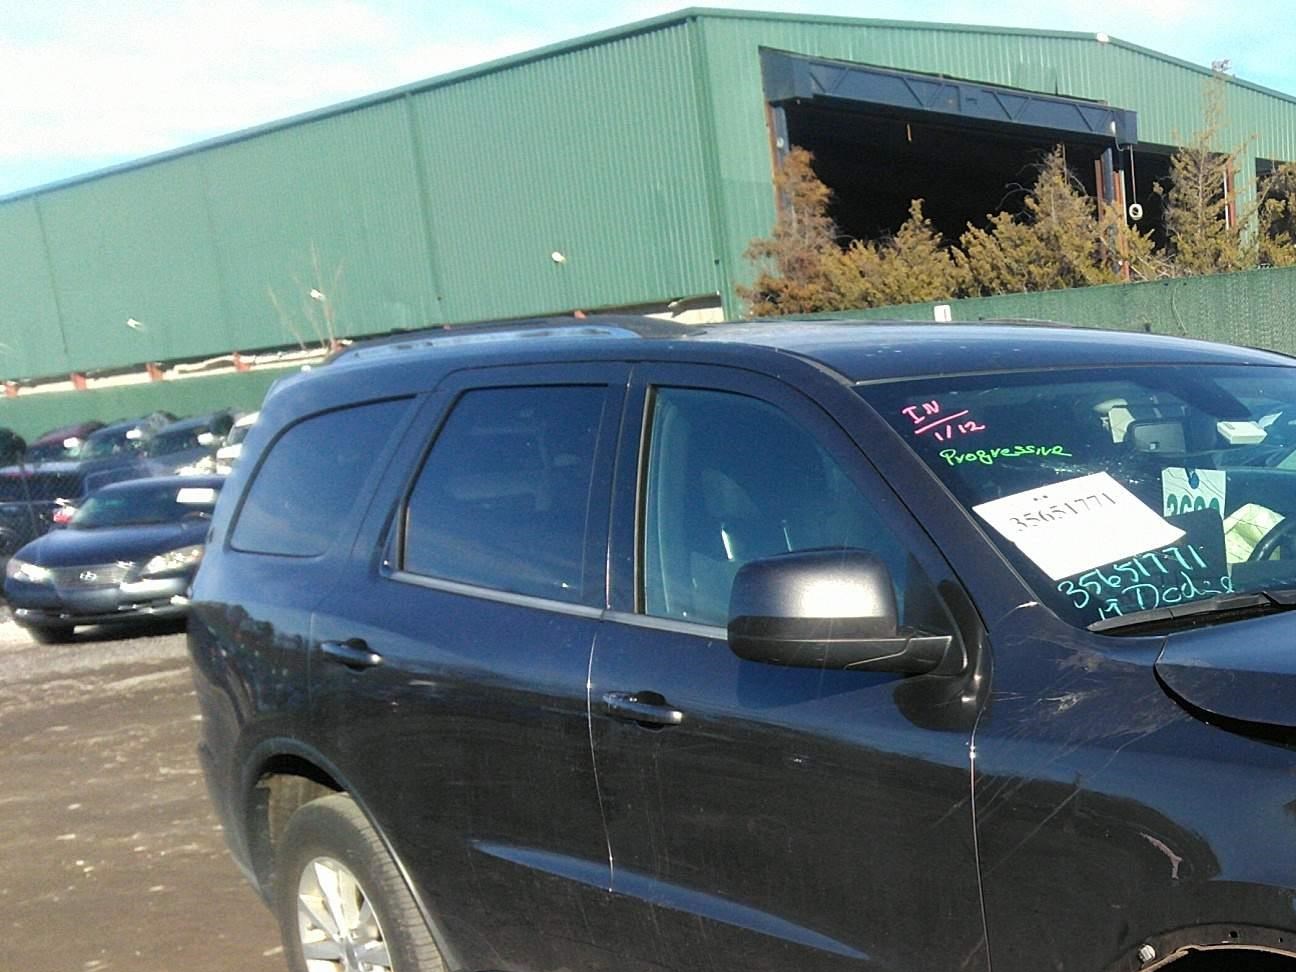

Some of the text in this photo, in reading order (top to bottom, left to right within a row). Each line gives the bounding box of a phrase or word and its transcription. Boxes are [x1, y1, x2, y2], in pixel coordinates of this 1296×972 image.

[902, 400, 941, 425] IN
[934, 420, 987, 442] 1/12
[938, 445, 1073, 467] Progressive
[1008, 492, 1117, 532] 35651771
[1057, 544, 1208, 609] 35651771
